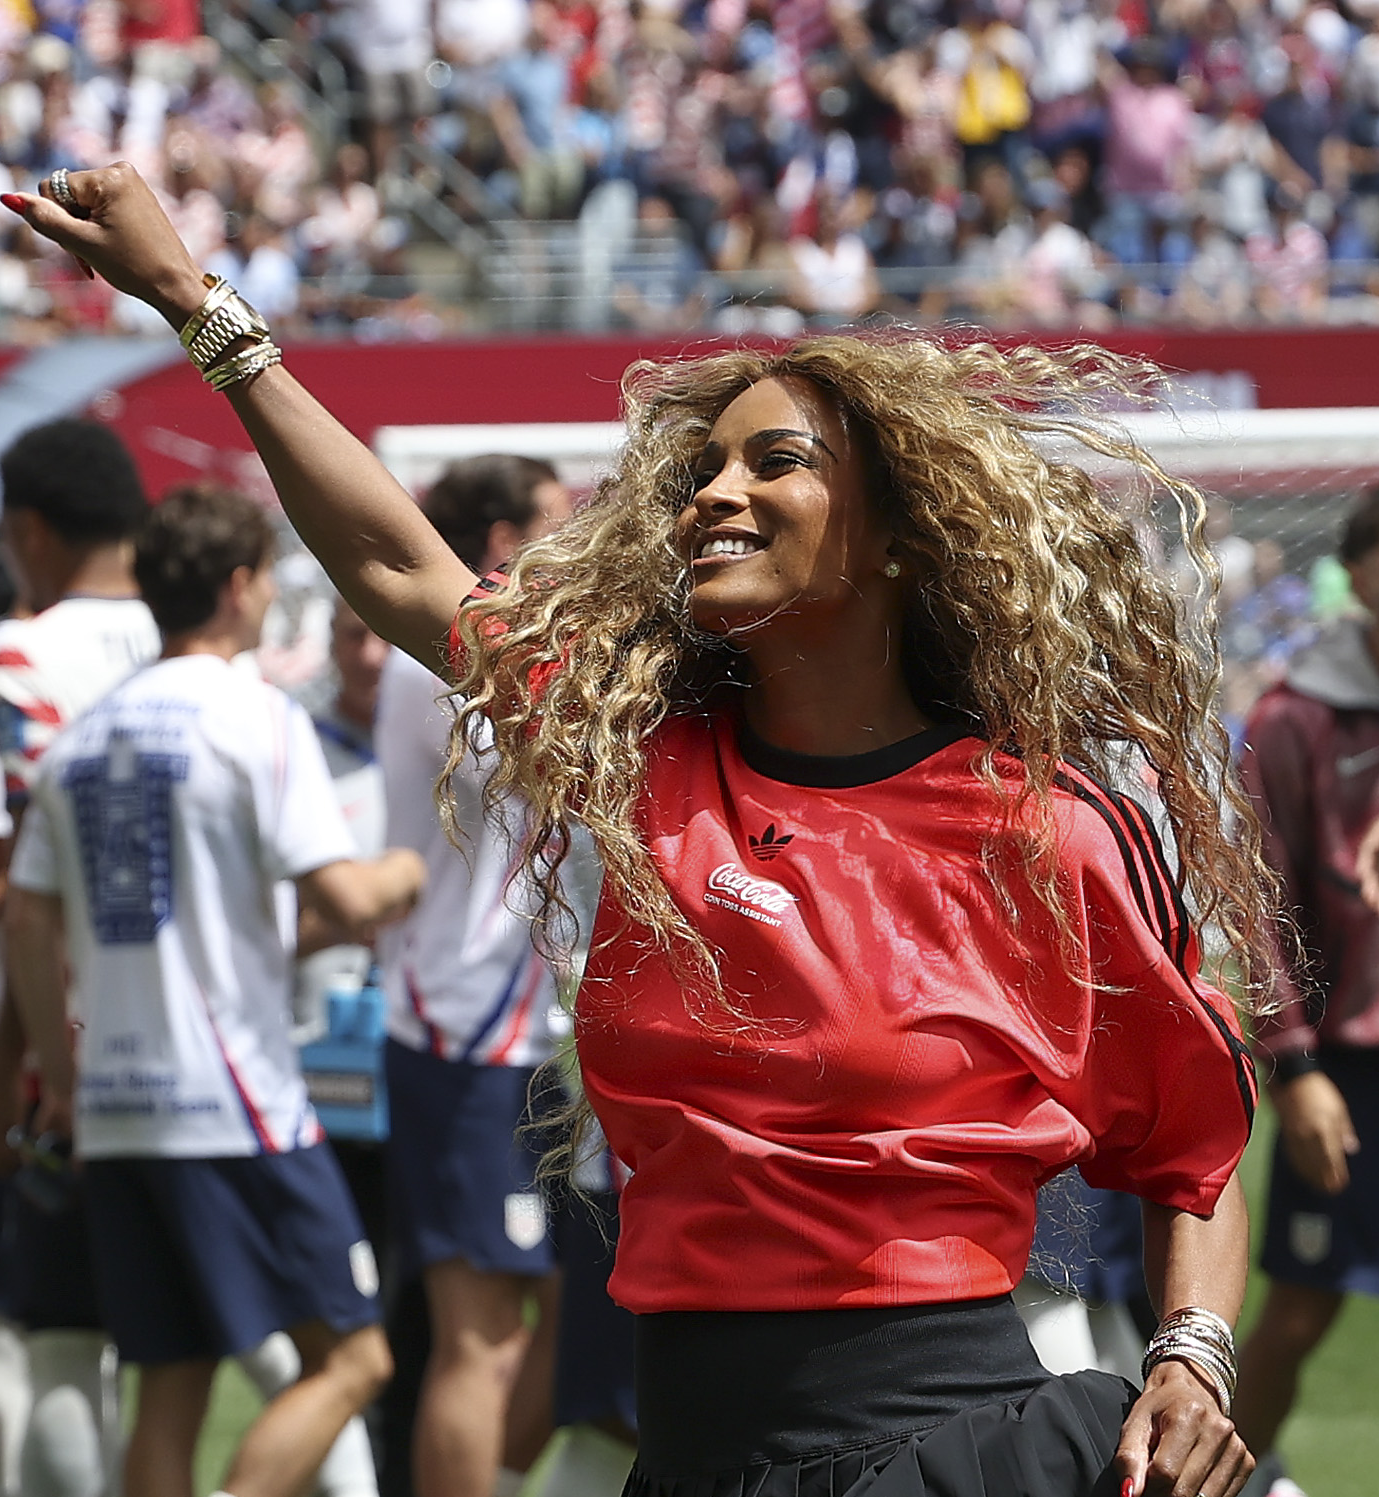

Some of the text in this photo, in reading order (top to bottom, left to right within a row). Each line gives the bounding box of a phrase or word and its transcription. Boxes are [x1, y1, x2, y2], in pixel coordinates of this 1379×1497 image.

[703, 893, 782, 927] COIN TOSS ASSISTANT
